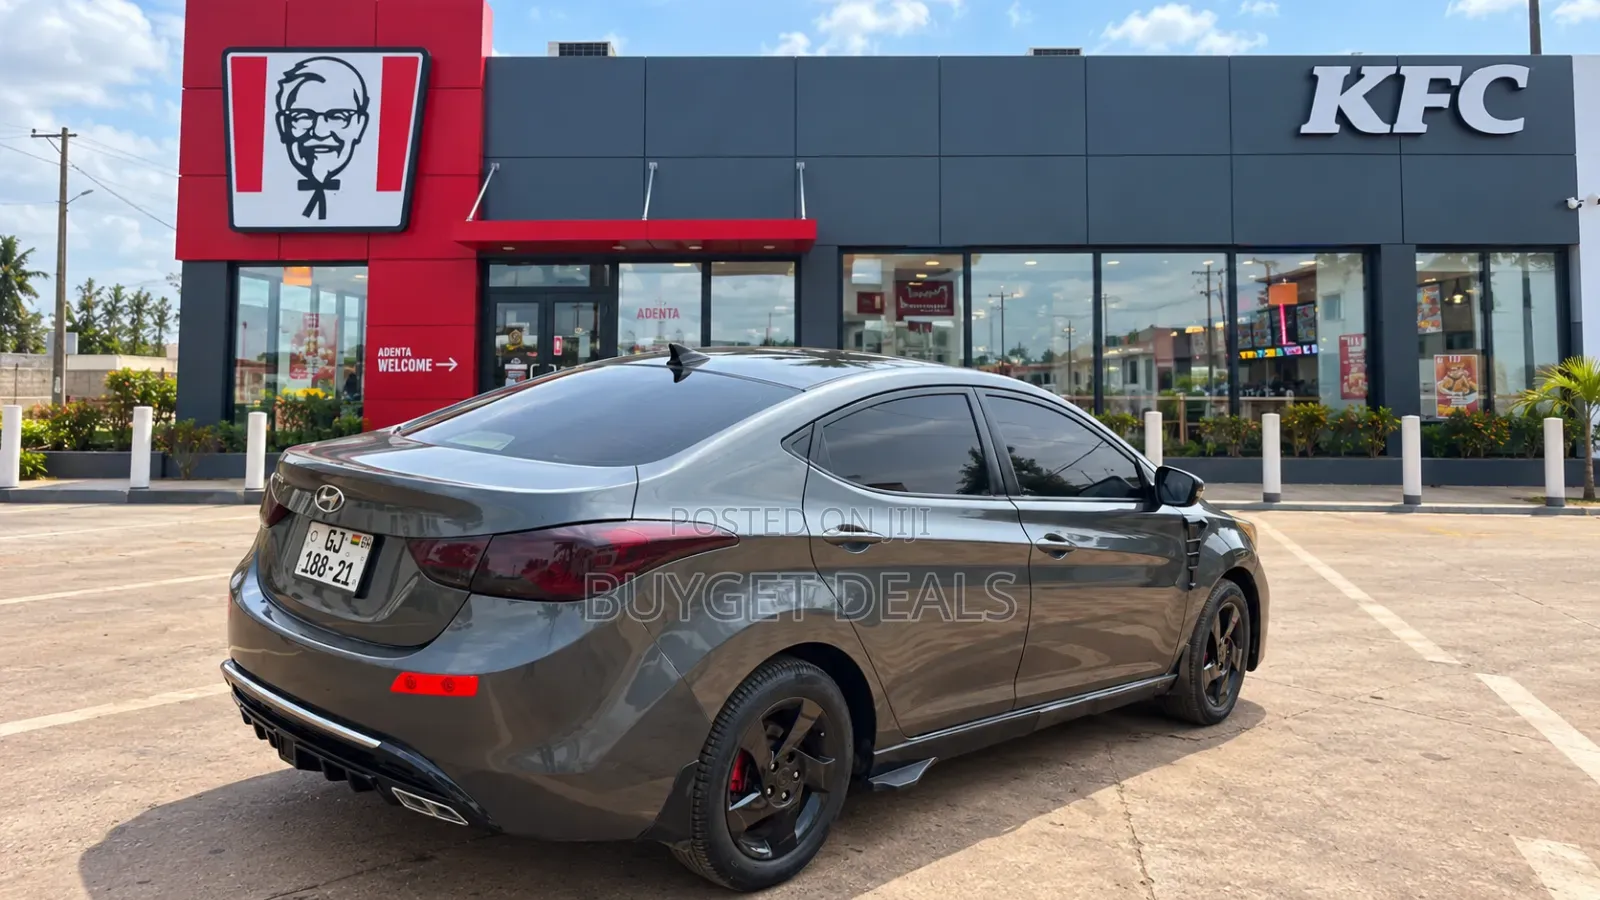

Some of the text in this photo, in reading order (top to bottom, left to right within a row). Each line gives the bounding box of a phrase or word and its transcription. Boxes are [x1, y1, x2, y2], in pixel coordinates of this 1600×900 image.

[1300, 64, 1530, 135] KFC
[637, 307, 680, 320] ADENTA
[378, 347, 412, 357] ADENTA
[378, 358, 433, 372] WELCOME
[324, 529, 346, 554] GJ
[301, 550, 354, 586] 188-21
